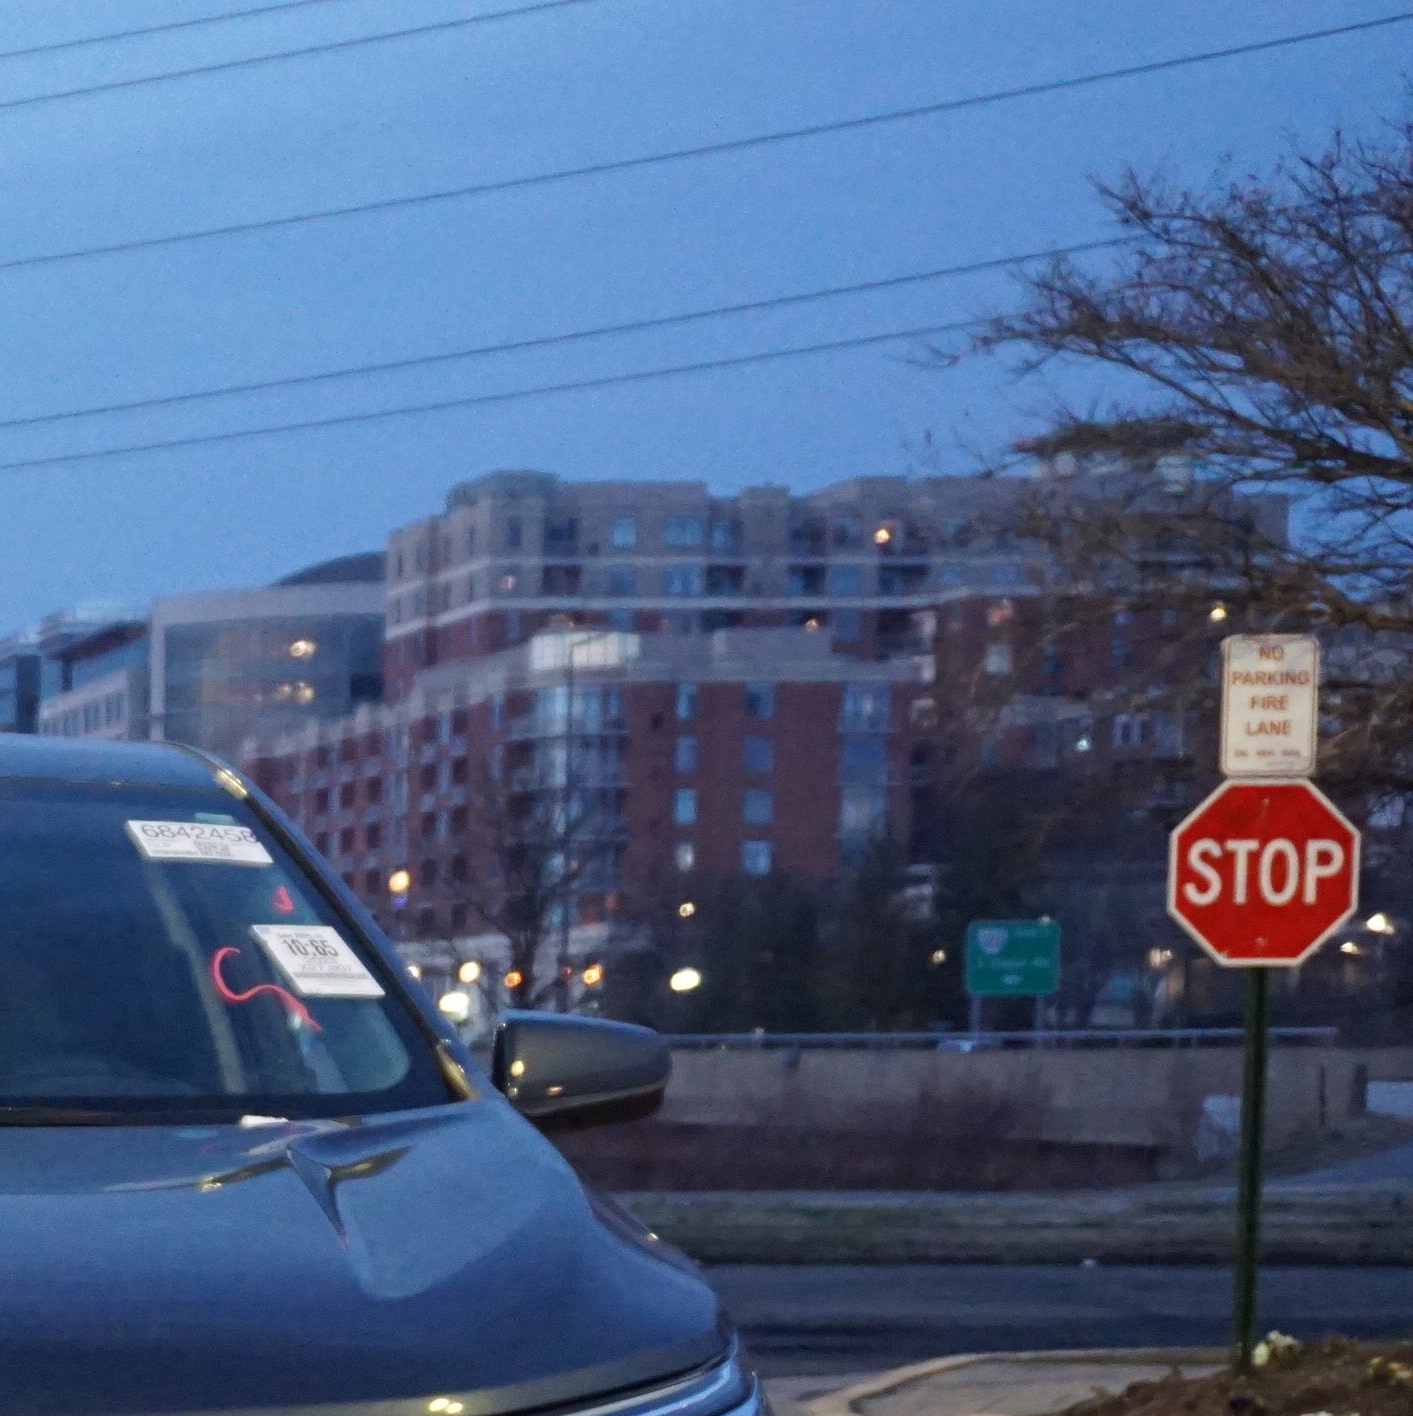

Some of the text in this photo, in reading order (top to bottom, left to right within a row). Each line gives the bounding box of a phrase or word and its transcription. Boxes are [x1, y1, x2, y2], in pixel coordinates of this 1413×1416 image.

[1259, 646, 1284, 660] NO
[1232, 670, 1310, 686] PARKING
[1251, 695, 1288, 711] FIRE
[1246, 721, 1291, 736] LANE
[140, 824, 258, 844] 6842458
[1183, 837, 1345, 906] STOP
